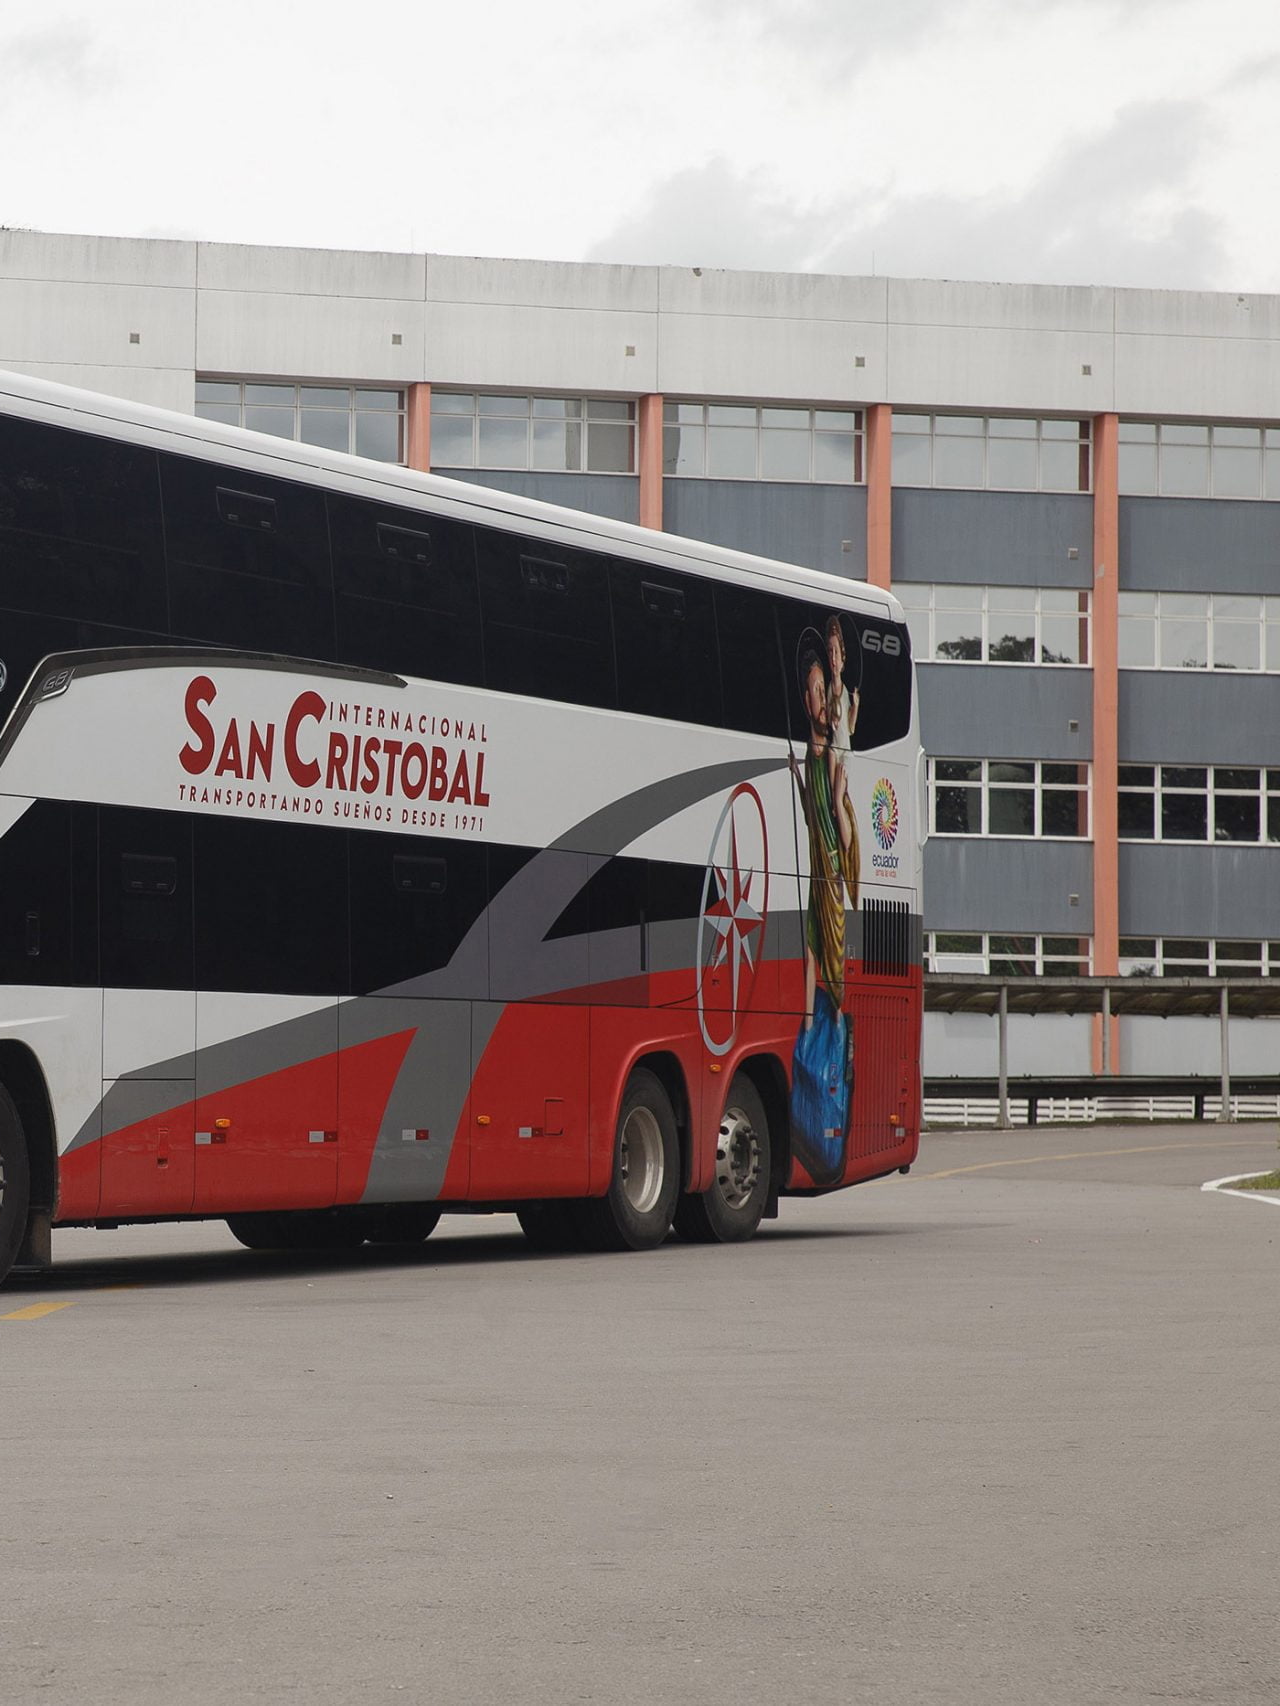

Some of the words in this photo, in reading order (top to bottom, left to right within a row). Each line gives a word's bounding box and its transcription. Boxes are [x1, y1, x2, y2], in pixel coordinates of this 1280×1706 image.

[861, 629, 900, 656] G8
[42, 671, 68, 691] G8
[329, 701, 488, 743] INTERNACIONAL
[179, 675, 275, 783] SAN
[284, 690, 490, 807] CRISTOBAL
[179, 784, 323, 814] TRANSPORTANDO
[333, 800, 392, 822] SUEÑOS
[402, 809, 445, 827] DESDE
[455, 815, 484, 831] 1971
[872, 853, 899, 868] ecuador
